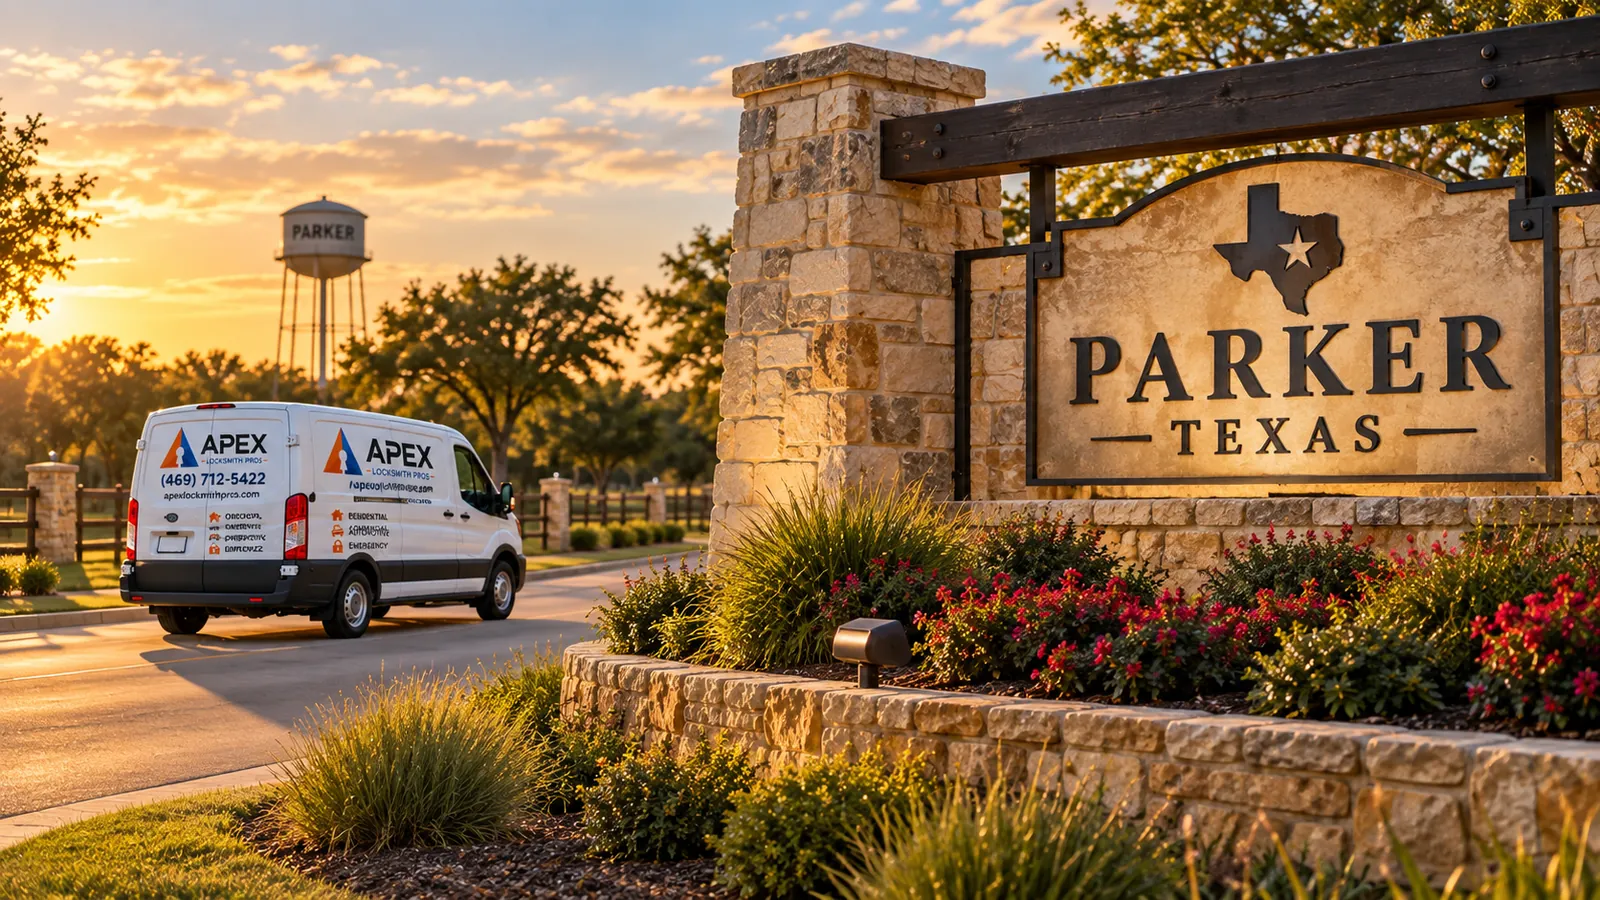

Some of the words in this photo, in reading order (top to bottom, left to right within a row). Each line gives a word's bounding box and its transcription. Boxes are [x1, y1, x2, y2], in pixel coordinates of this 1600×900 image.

[292, 223, 355, 241] PARKER
[1069, 315, 1512, 405] PARKER
[201, 433, 267, 455] APEX
[1170, 414, 1382, 455] TEXAS
[206, 457, 243, 465] LOCKSMITH
[244, 456, 263, 464] PROS
[366, 438, 434, 469] APEX
[161, 473, 196, 488] (469)
[201, 472, 266, 486] 712-5422
[372, 468, 412, 478] LOCKSMITH
